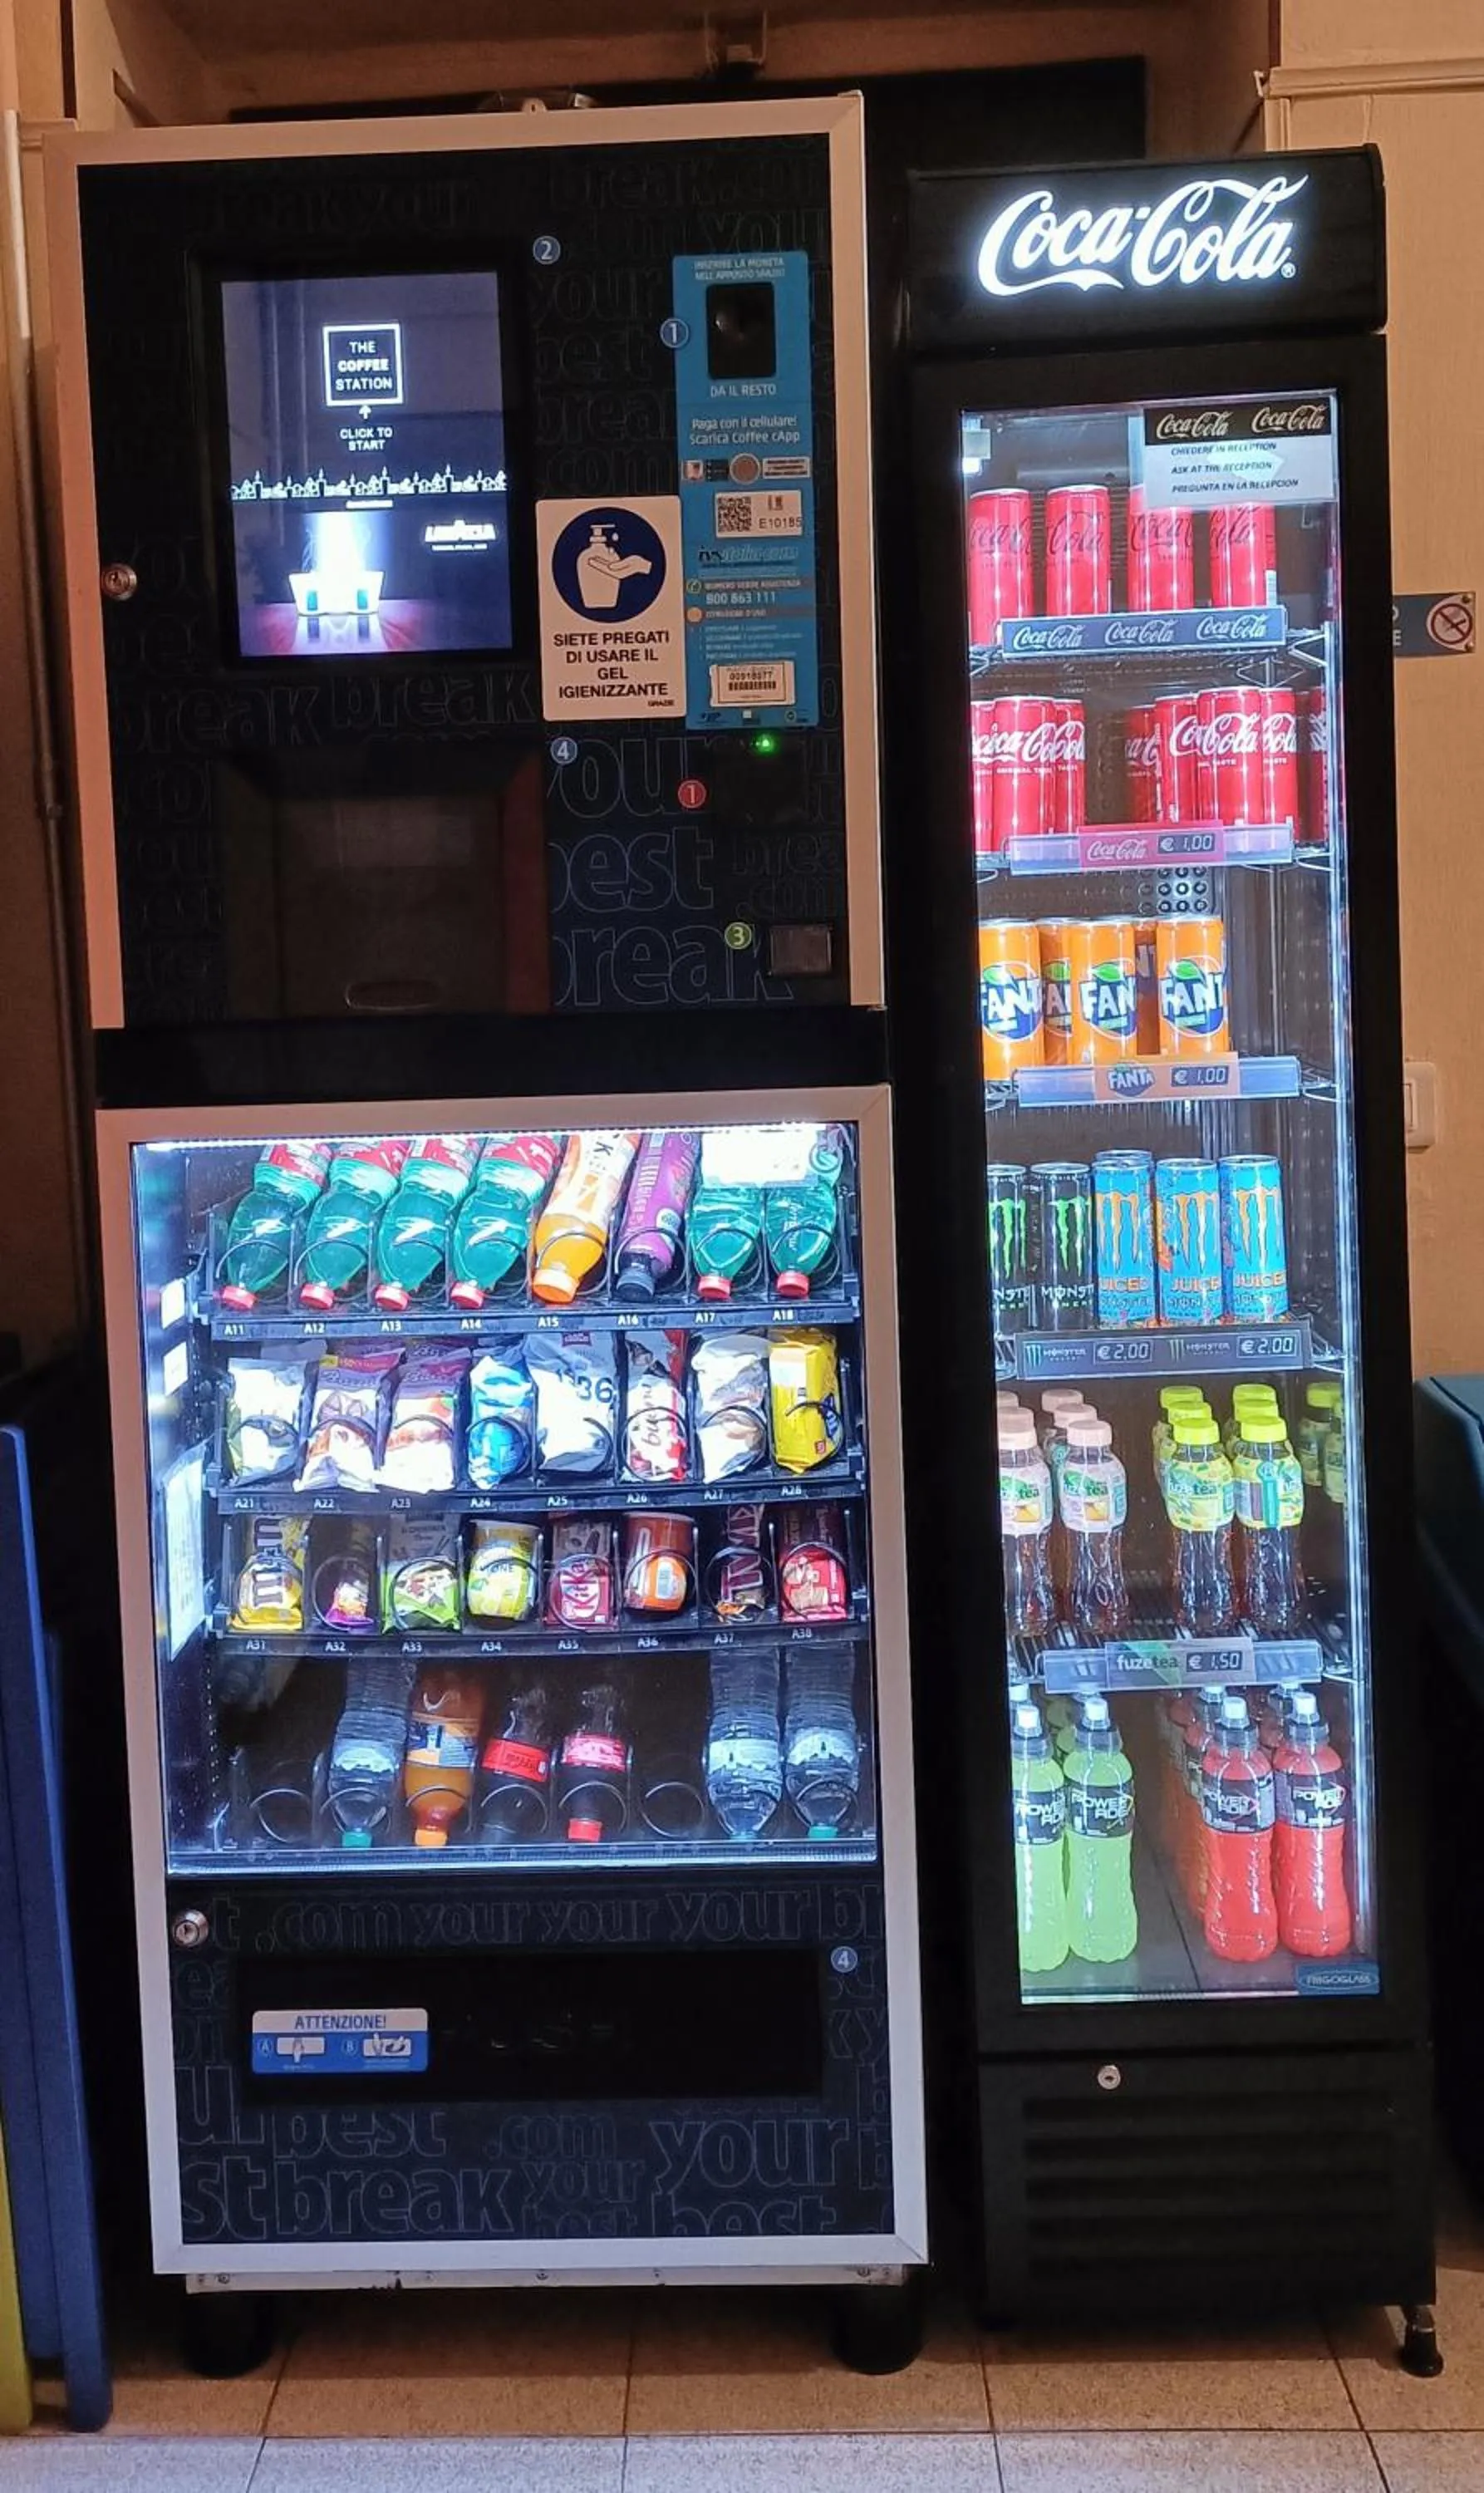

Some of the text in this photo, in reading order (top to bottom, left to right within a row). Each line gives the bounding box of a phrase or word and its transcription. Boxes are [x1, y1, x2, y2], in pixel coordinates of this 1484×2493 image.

[350, 342, 376, 353] THE
[337, 359, 389, 372] COFFEE
[336, 378, 392, 391] STATION
[710, 384, 776, 397] DA IL RESTO
[692, 418, 718, 431] Paga
[720, 419, 738, 430] con
[1156, 405, 1329, 439] Coca-Cola Coca-Cola
[340, 426, 393, 439] CLICK TO
[690, 433, 729, 445] Scarica
[732, 432, 769, 444] Coffee
[348, 440, 386, 451] START
[1171, 445, 1213, 456] CHIEDERE
[1171, 465, 1188, 475] ASK
[1190, 465, 1202, 474] AT
[1205, 464, 1221, 473] THE
[1172, 482, 1220, 493] PREGUNTA
[1222, 482, 1234, 492] EN
[1236, 481, 1247, 490] LA
[757, 591, 776, 602] 111
[1013, 613, 1270, 651] Coca-Cola Coca-Cola Coca-Cola
[553, 631, 669, 647] SIETE PREGATI
[566, 648, 658, 664] DI USARE IL
[597, 667, 628, 680] GEL
[558, 682, 668, 699] IGIENIZZANTE
[1088, 839, 1148, 861] Coca-Cola
[1161, 838, 1174, 852] €
[1108, 1067, 1154, 1089] FANTA
[1175, 1070, 1187, 1084] €
[618, 1315, 638, 1325] A16
[695, 1312, 715, 1324] A17
[773, 1310, 793, 1320] A18
[381, 1320, 401, 1331] A13
[461, 1319, 482, 1330] A14
[538, 1317, 558, 1327] A15
[224, 1324, 243, 1335] A11
[304, 1322, 325, 1334] A12
[1098, 1345, 1111, 1360] €
[1241, 1339, 1255, 1353] €
[627, 1493, 647, 1503] A26
[705, 1489, 724, 1499] A27
[235, 1499, 254, 1509] A21
[314, 1499, 335, 1509] A22
[391, 1498, 411, 1508] A23
[469, 1497, 491, 1507] A24
[548, 1496, 568, 1506] A25
[247, 1640, 265, 1650] A31
[326, 1641, 346, 1651] A32
[402, 1642, 422, 1652] A33
[481, 1641, 502, 1651] A34
[638, 1637, 658, 1647] A36
[1188, 1655, 1201, 1669] €
[294, 2014, 386, 2030] ATTENZIONE!
[648, 2118, 850, 2196] your
[275, 2160, 515, 2236] break
